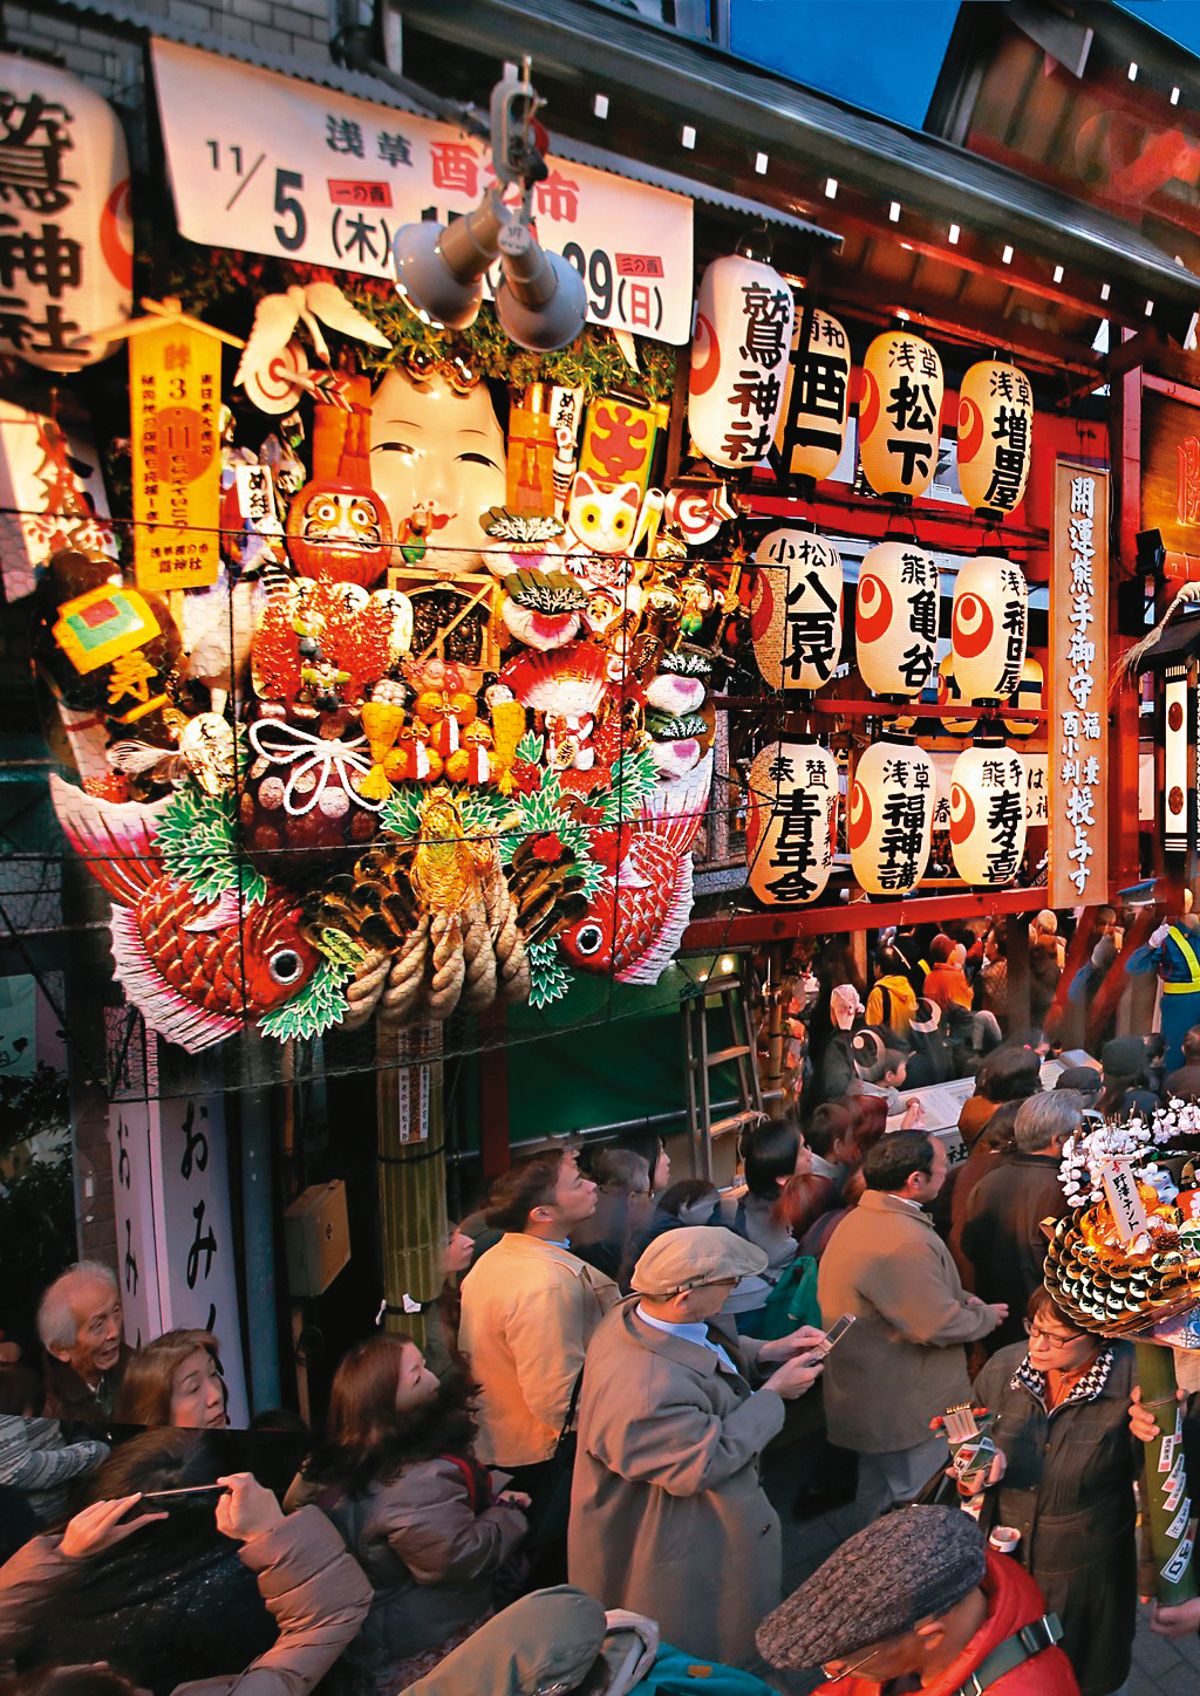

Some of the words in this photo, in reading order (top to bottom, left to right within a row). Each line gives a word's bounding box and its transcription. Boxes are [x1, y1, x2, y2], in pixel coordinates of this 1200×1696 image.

[326, 114, 414, 169] 浅草
[430, 141, 581, 224] 酉市
[721, 281, 791, 462] 鷲神社
[889, 341, 938, 379] 浅草
[990, 370, 1030, 406] 浅草
[886, 376, 937, 485] 松下
[983, 408, 1029, 511] 増田屋
[901, 553, 938, 584] 熊手
[781, 571, 838, 681] 八百代
[898, 589, 938, 687] 亀谷
[768, 756, 829, 790] 奉賛
[883, 759, 930, 791] 浅草
[982, 759, 1023, 788] 熊手
[765, 788, 821, 900] 青年会
[878, 791, 925, 890] 福神講
[982, 789, 1023, 884] 寿々喜
